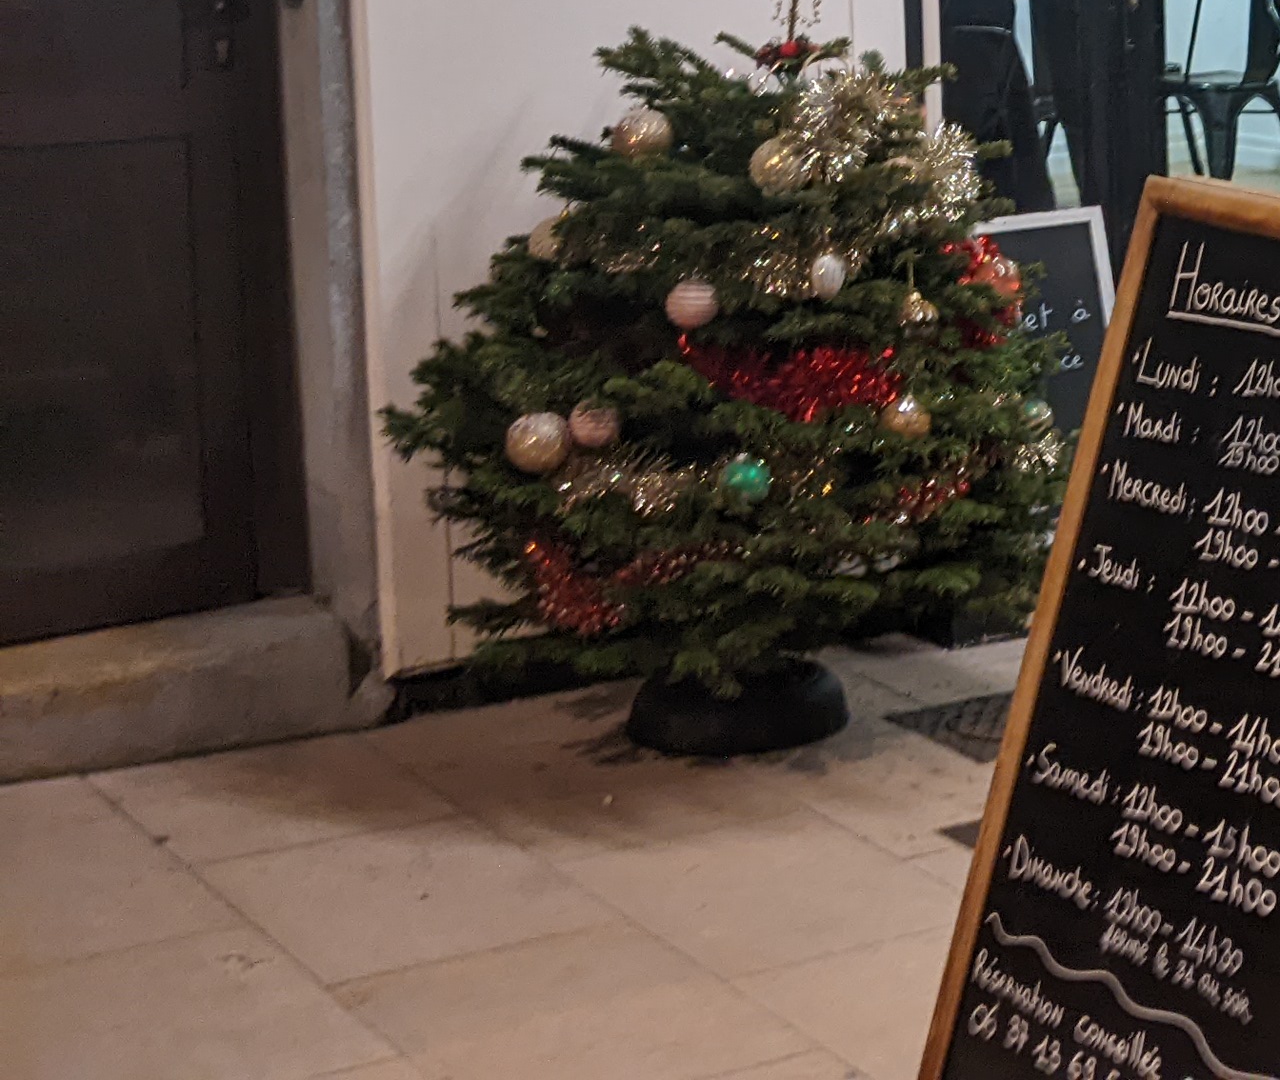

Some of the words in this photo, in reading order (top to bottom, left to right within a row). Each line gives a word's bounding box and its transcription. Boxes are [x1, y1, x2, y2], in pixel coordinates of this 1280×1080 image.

[1217, 446, 1280, 475] 19h00
[1203, 487, 1269, 536] 12h00
[1193, 527, 1259, 570] 19h00
[1168, 577, 1236, 620] 12h00
[1163, 612, 1228, 658] 19h00
[1148, 684, 1208, 733] 12h00
[1137, 721, 1199, 770] 19h00
[1121, 782, 1183, 835] 12h00
[1109, 821, 1177, 873] 19h00
[1195, 856, 1278, 917] 21h00
[967, 1001, 1000, 1041] 06
